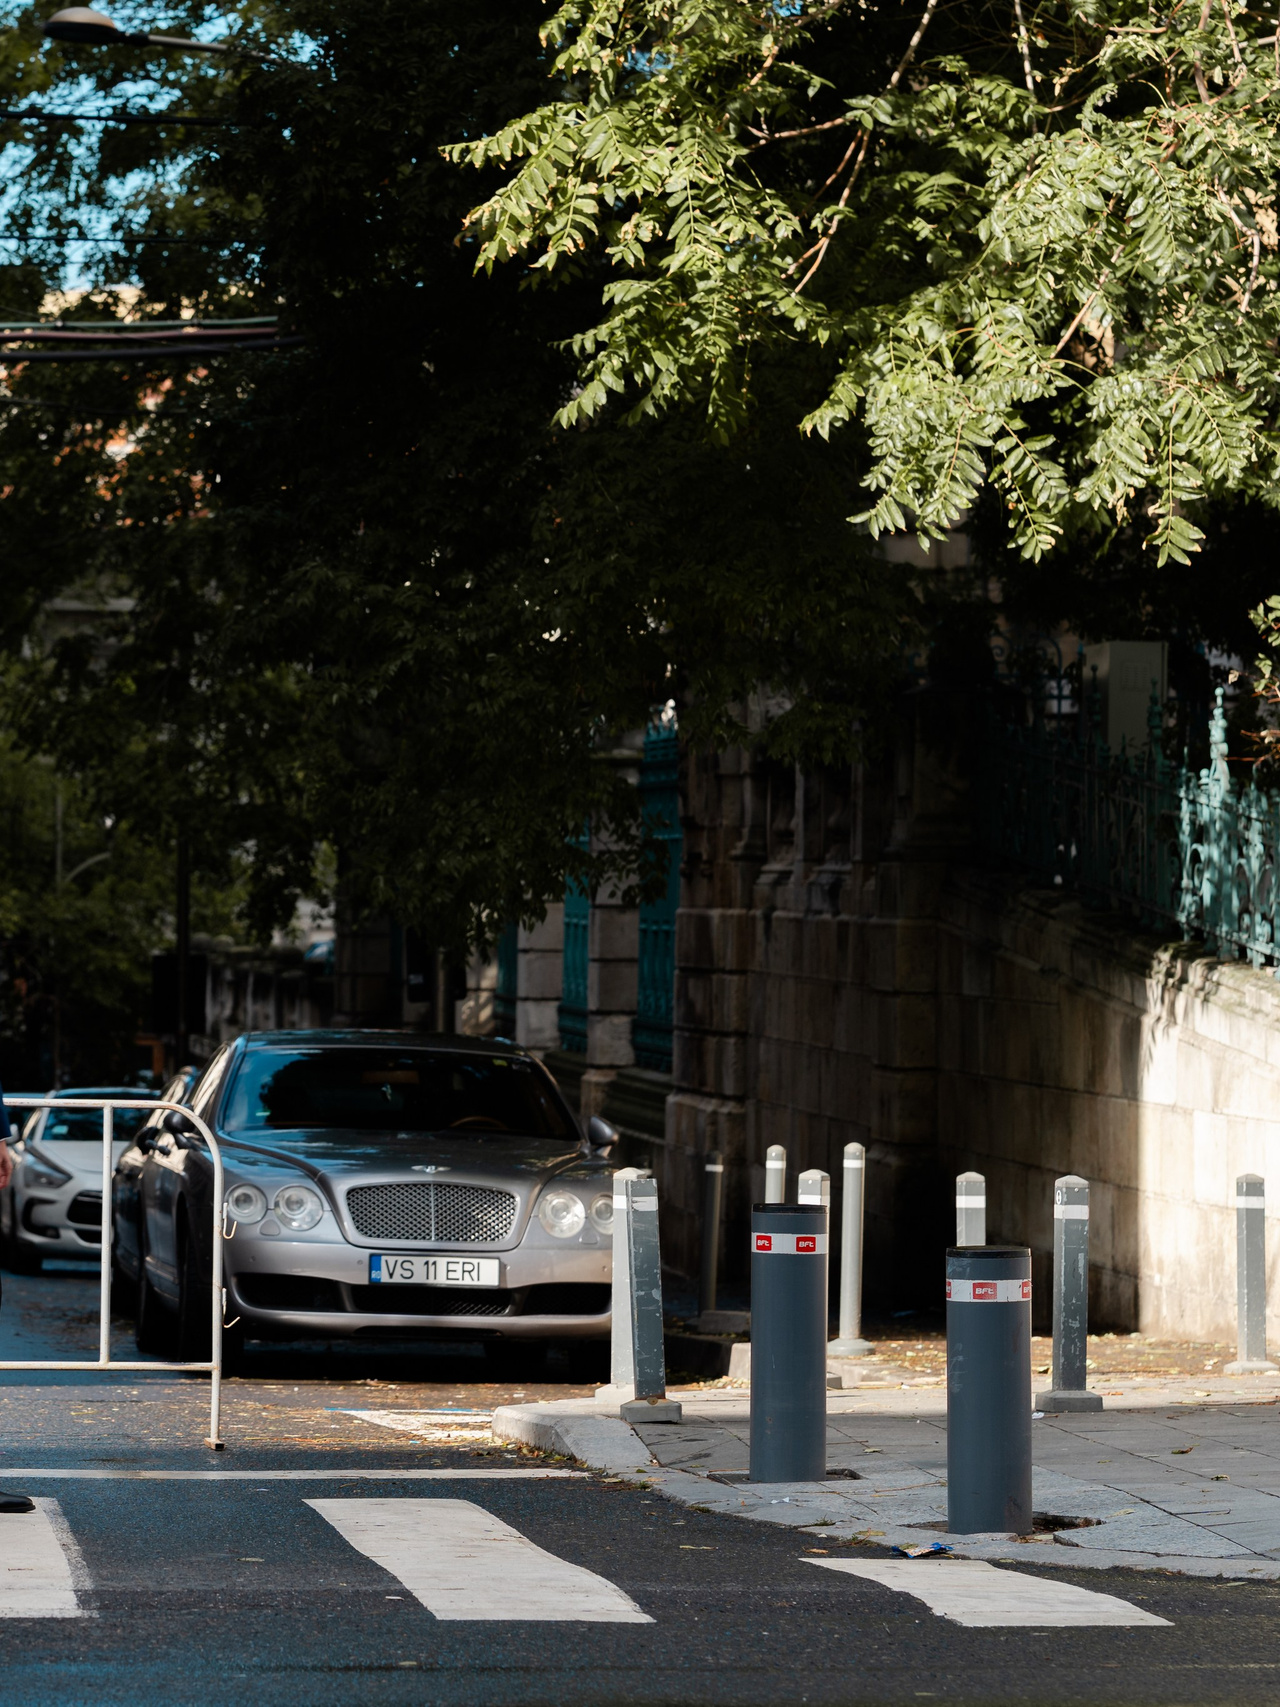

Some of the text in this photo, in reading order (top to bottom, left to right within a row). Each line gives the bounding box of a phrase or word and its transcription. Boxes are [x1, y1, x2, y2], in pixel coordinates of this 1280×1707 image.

[385, 1259, 480, 1282] VS 11 ERI
